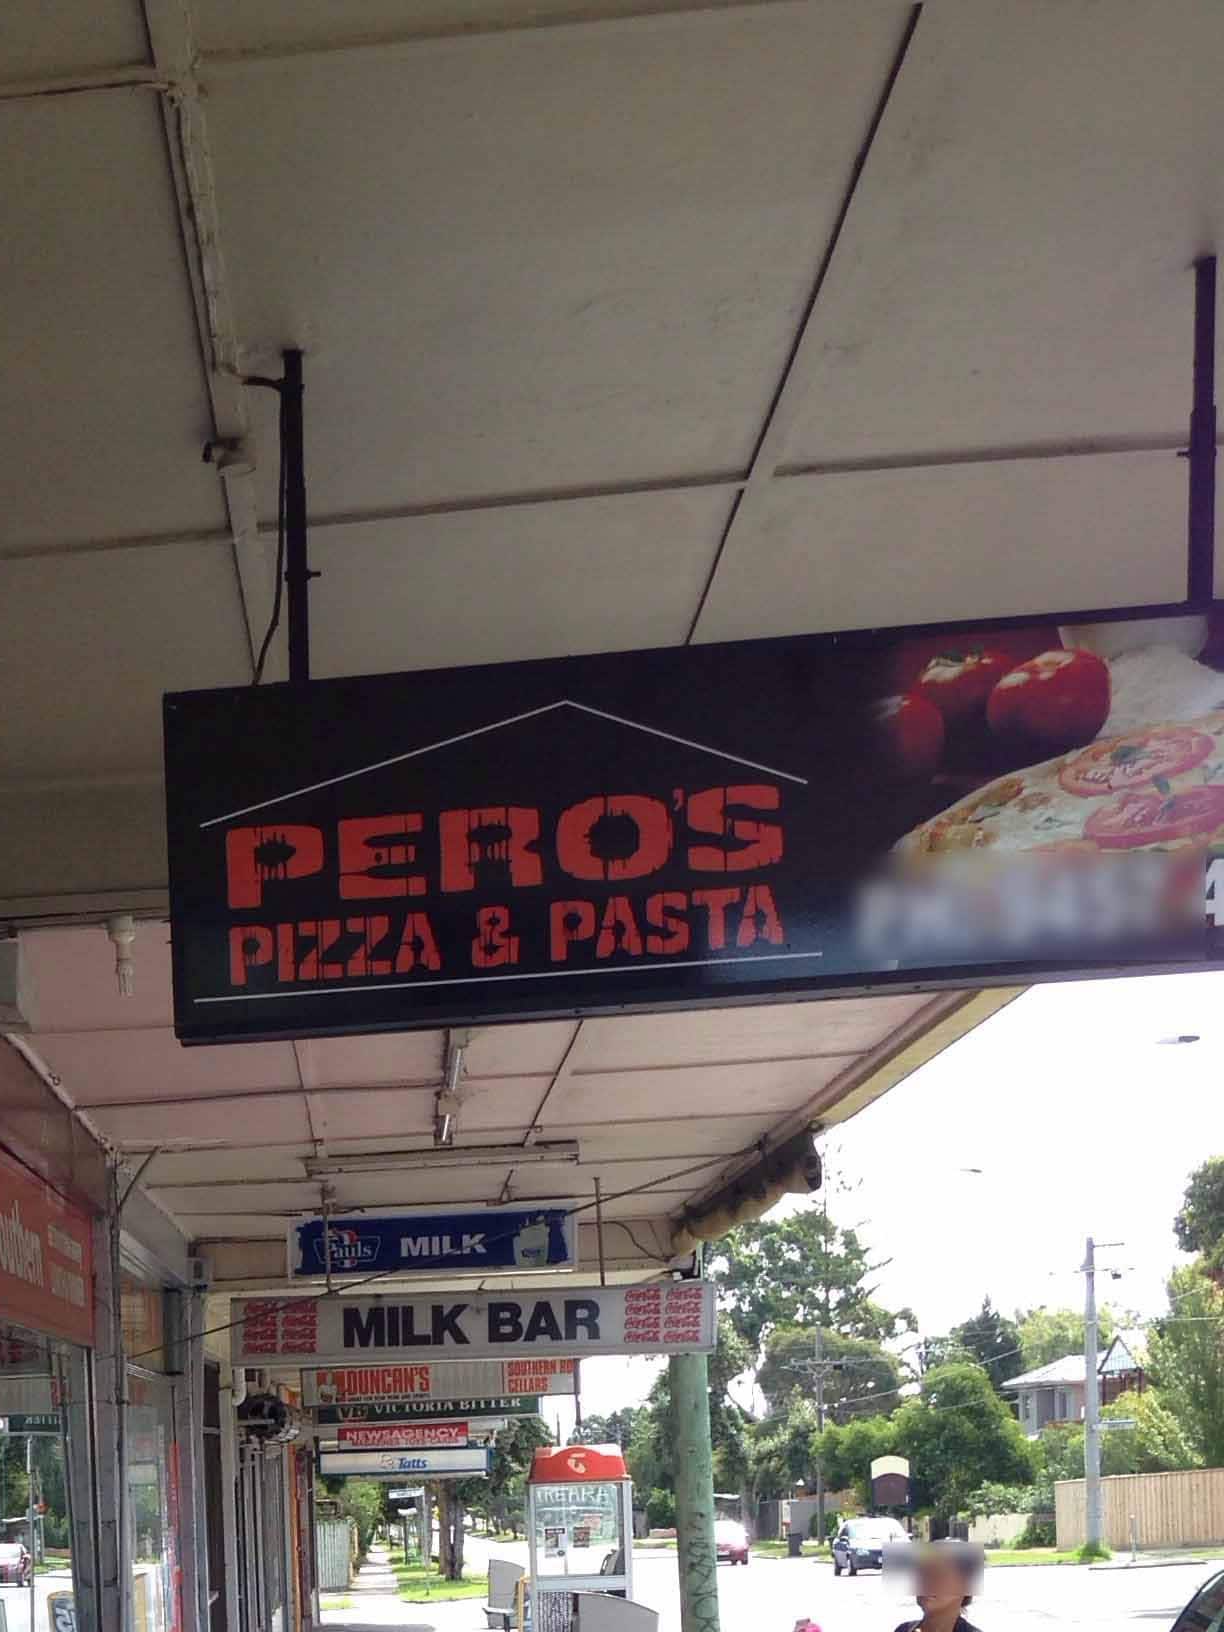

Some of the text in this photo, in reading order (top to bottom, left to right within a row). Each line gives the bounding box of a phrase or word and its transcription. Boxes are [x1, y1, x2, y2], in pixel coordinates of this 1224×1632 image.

[226, 784, 784, 909] PERO'S
[228, 912, 441, 985] PIZZA
[471, 905, 519, 967] &
[550, 885, 784, 961] PASTA
[400, 1233, 487, 1258] MILK
[343, 1302, 471, 1348] MILK
[487, 1299, 601, 1344] BAR
[345, 1365, 431, 1393] DUNCAN'S
[508, 1359, 556, 1376] SOUTHERN
[508, 1377, 548, 1393] CELLARS
[346, 1427, 459, 1441] NEWSAGENCY
[397, 1457, 427, 1470] Tatts
